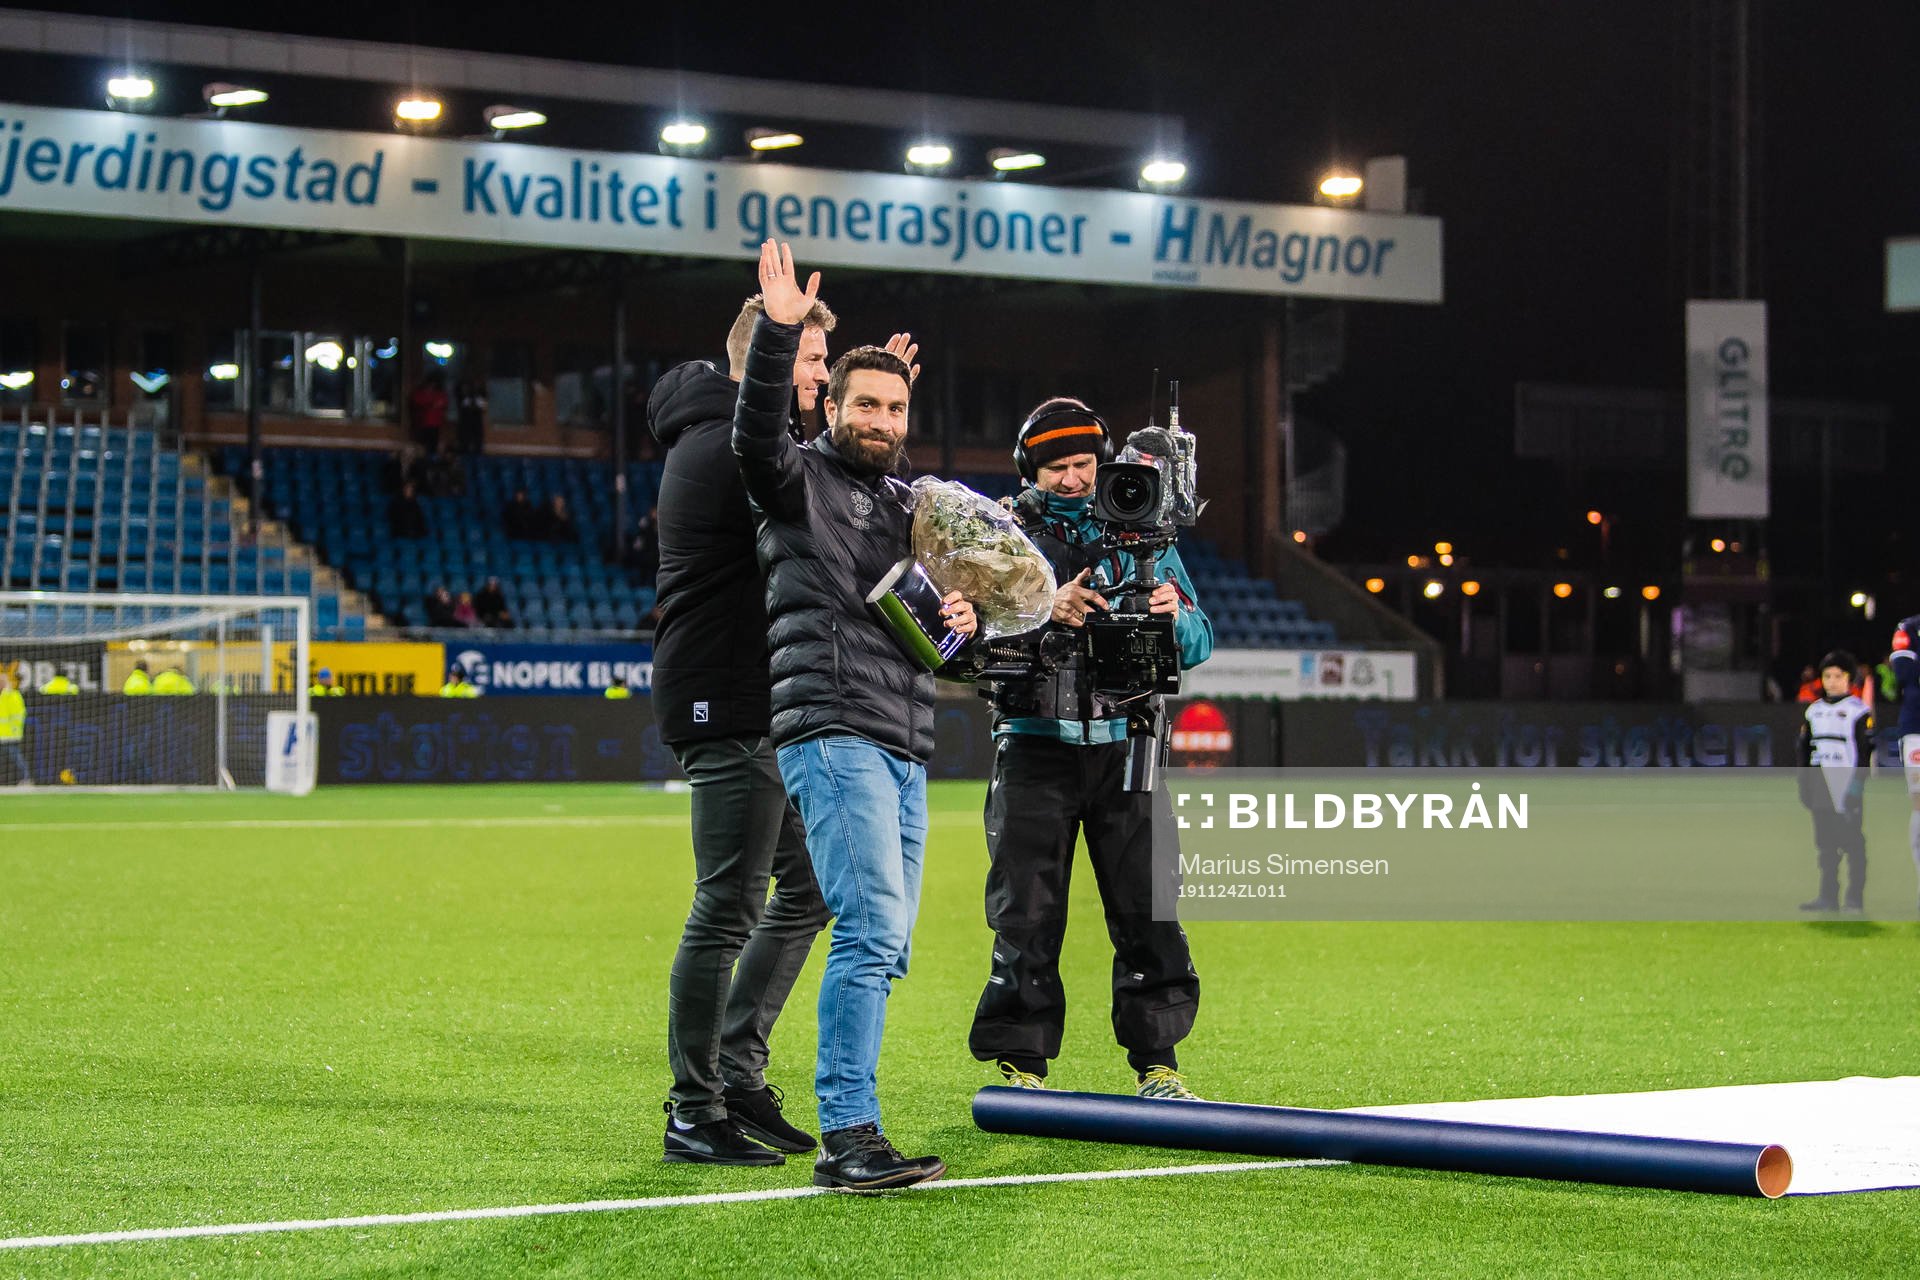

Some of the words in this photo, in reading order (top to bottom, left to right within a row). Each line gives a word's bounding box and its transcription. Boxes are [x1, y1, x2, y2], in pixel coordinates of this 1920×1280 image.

[0, 117, 383, 213] jerdingstad
[464, 158, 686, 230] Kvalitet
[704, 172, 718, 231] i
[738, 190, 1090, 263] generasjoner
[1205, 212, 1396, 284] Magnor
[853, 517, 870, 530] DNB
[493, 660, 582, 688] NOPEK
